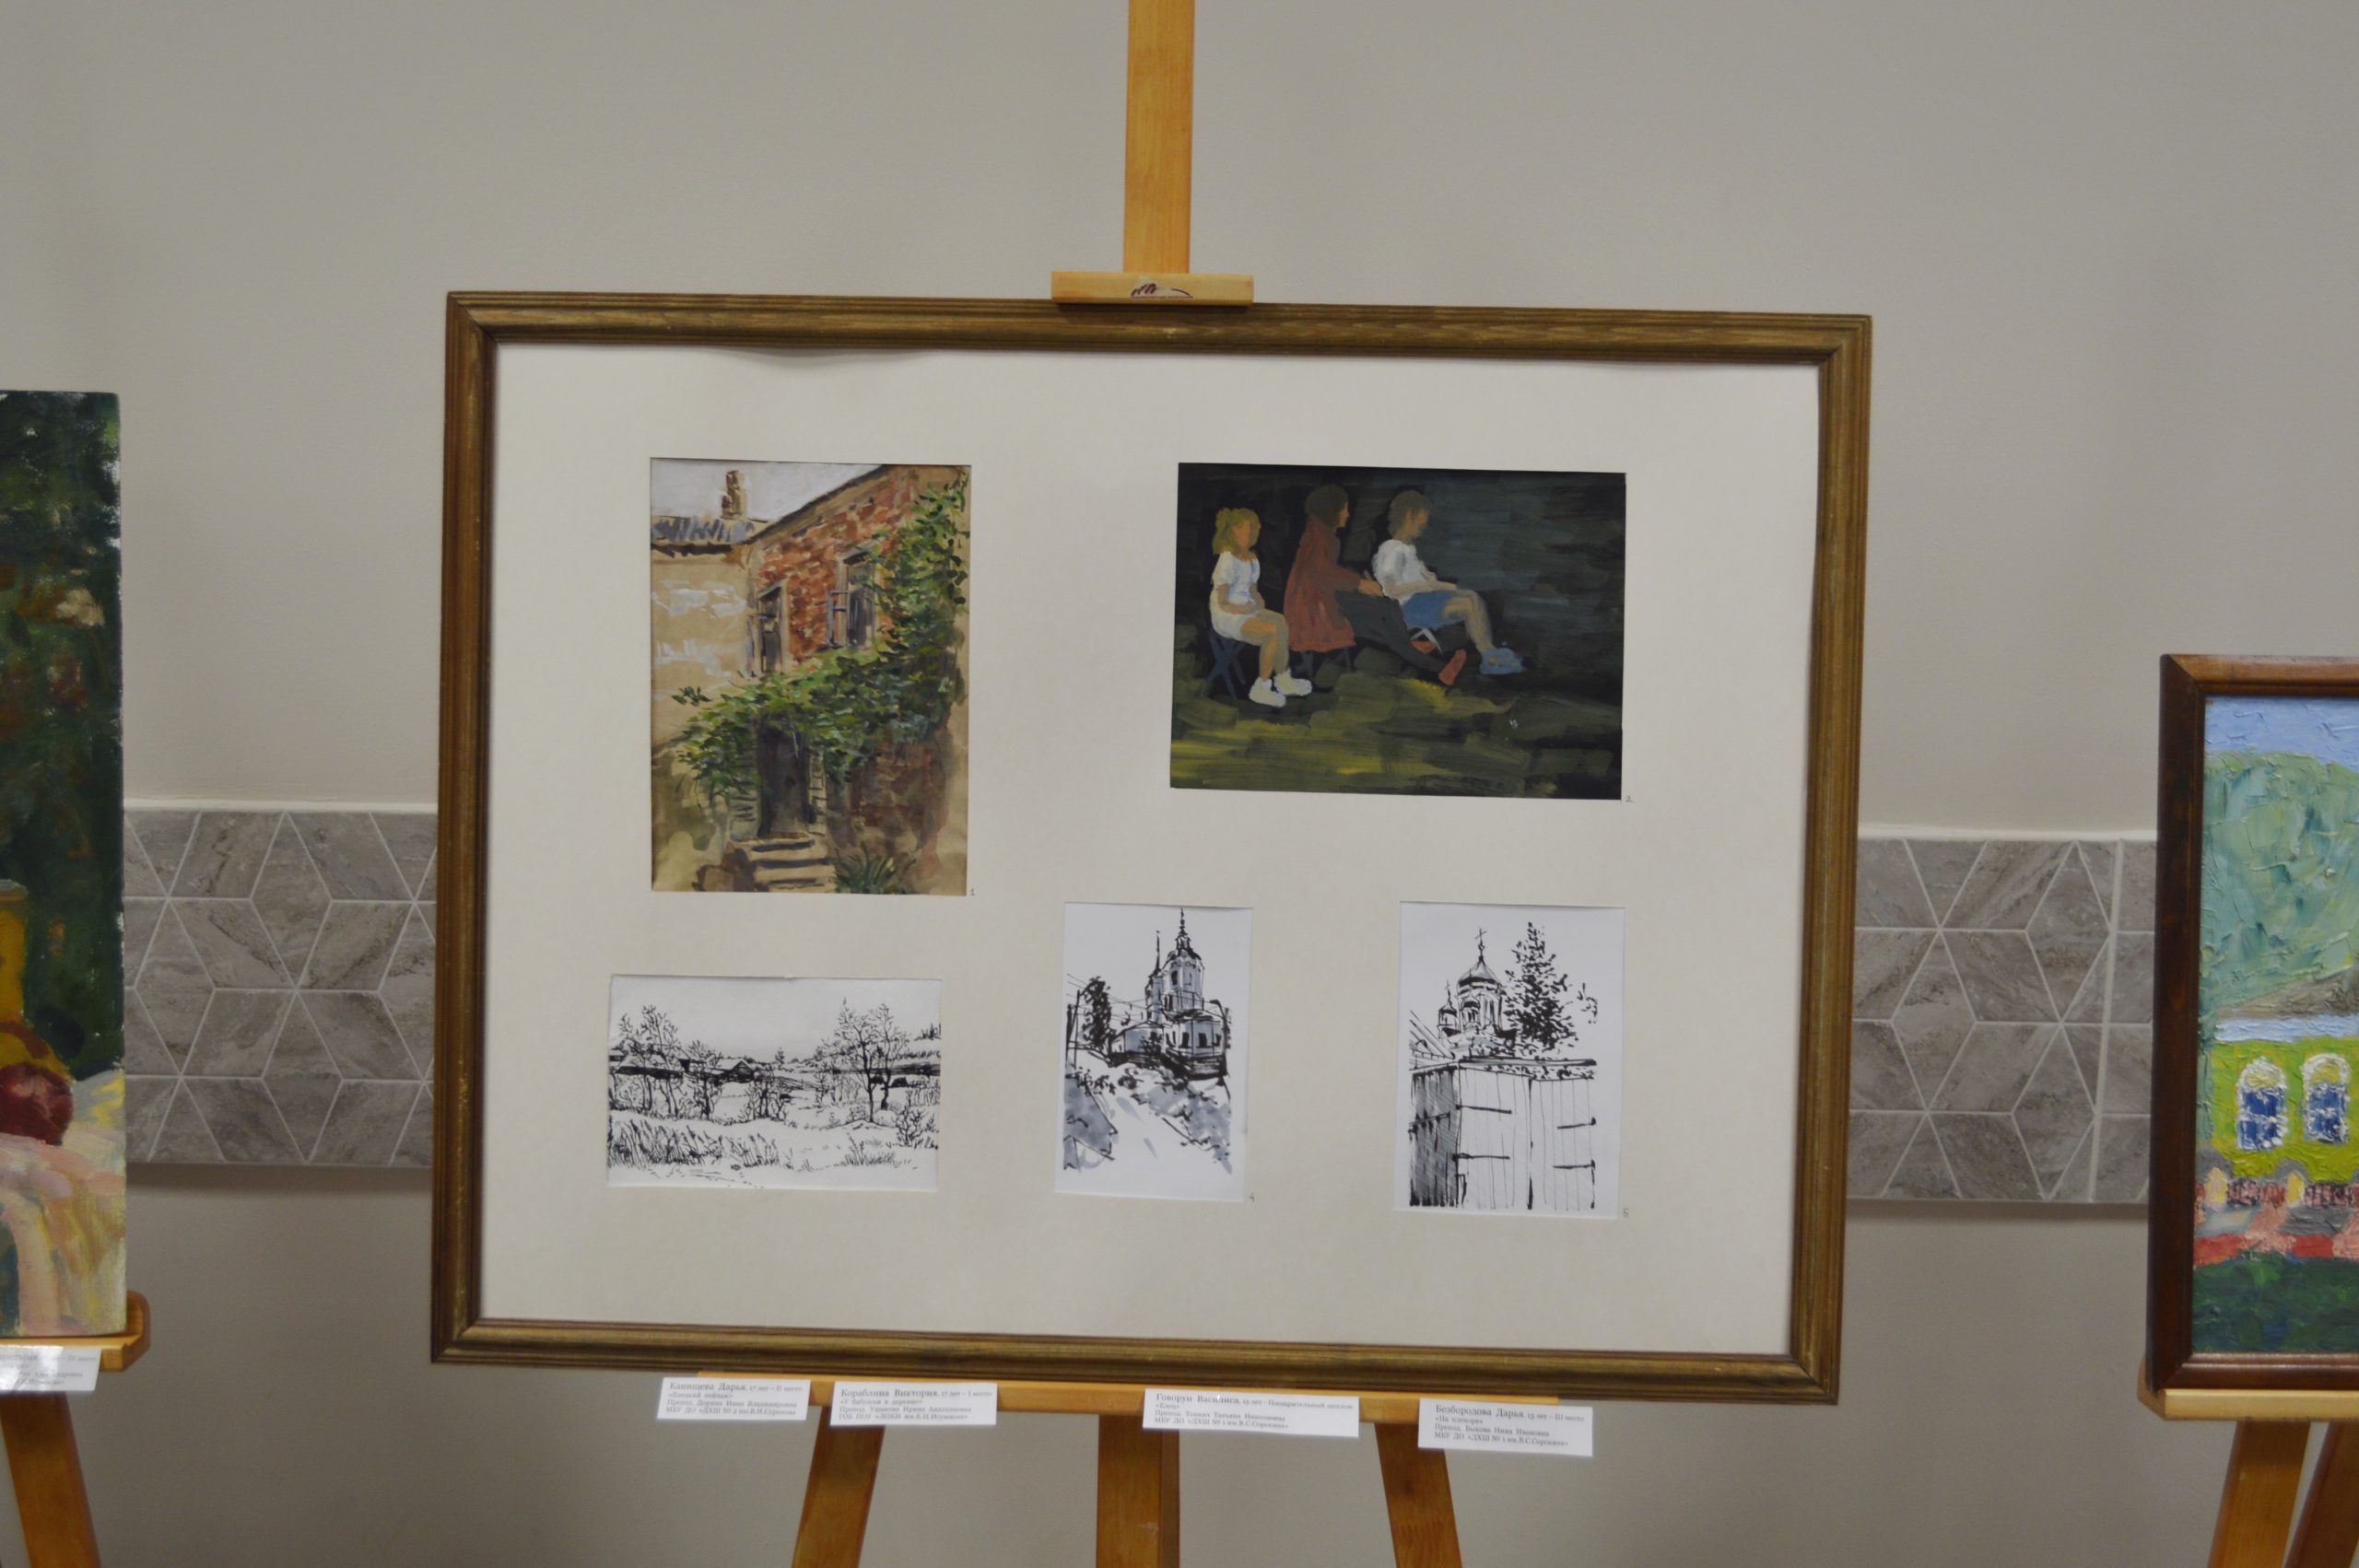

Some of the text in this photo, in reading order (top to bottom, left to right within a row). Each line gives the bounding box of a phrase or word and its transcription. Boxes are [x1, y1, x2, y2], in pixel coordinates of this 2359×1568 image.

[841, 1388, 889, 1398] Кораблина
[1156, 1393, 1191, 1403] Говорун
[1436, 1404, 1491, 1416] Безбородова
